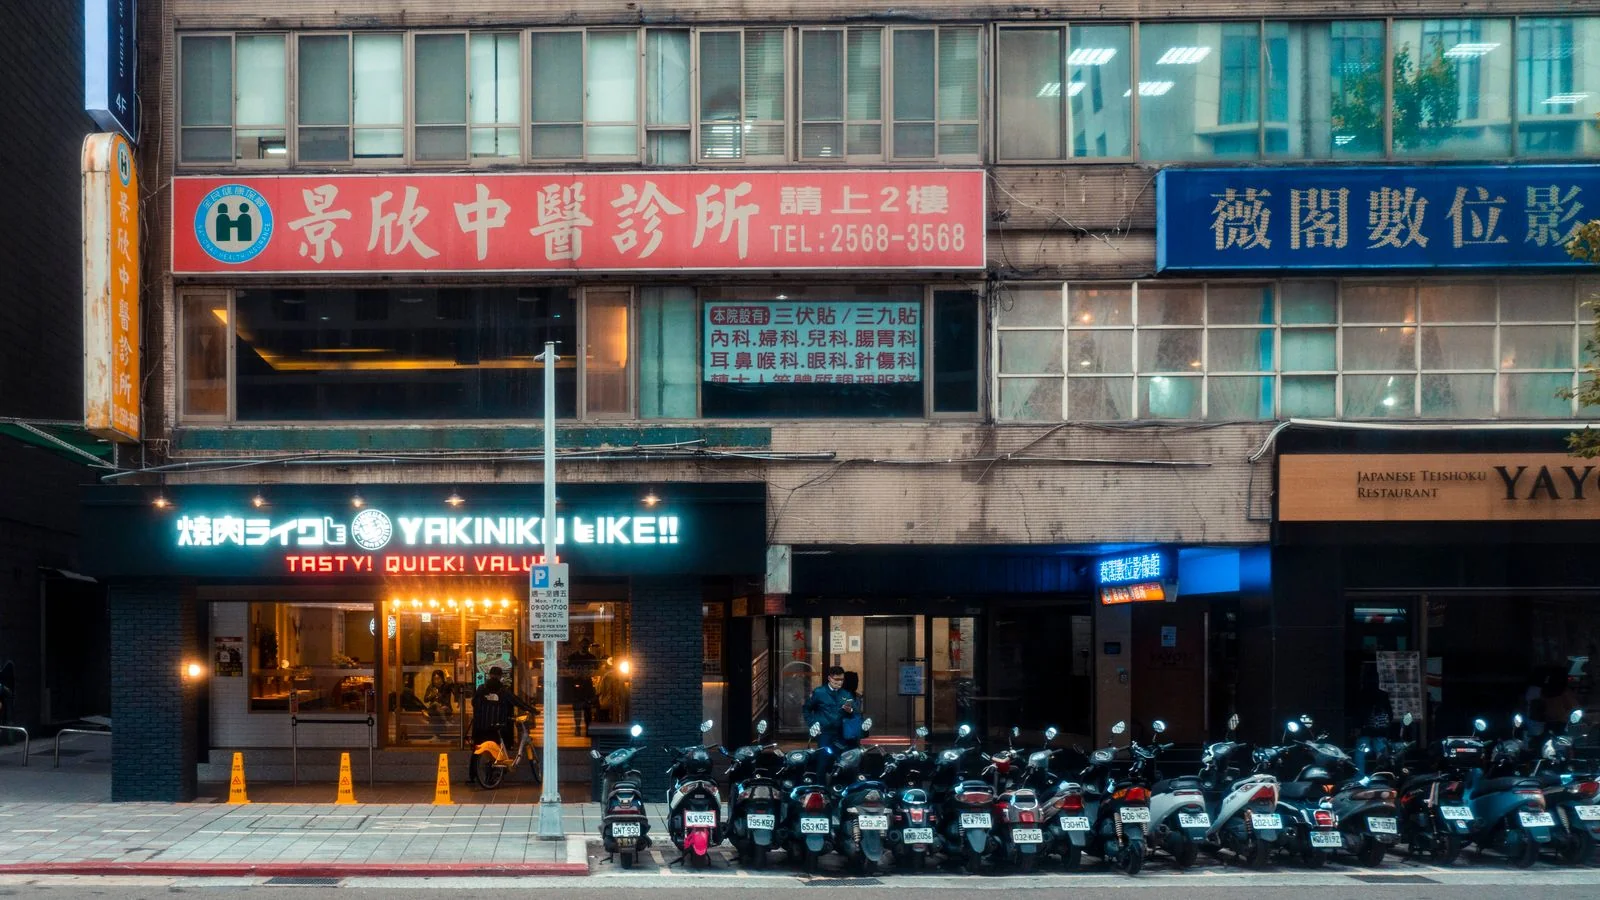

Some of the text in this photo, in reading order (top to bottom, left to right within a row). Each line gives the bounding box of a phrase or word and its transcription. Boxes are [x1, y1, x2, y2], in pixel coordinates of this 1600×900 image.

[115, 93, 127, 114] 4F
[780, 185, 949, 215] 請上2樓
[288, 181, 760, 263] 景欣中醫診所
[1210, 185, 1585, 250] 薇閣數位影
[770, 223, 965, 252] TEL:2568-3568
[1493, 465, 1600, 500] YAY
[286, 556, 560, 573] TASTY! QUICK! VALU
[534, 569, 546, 585] P
